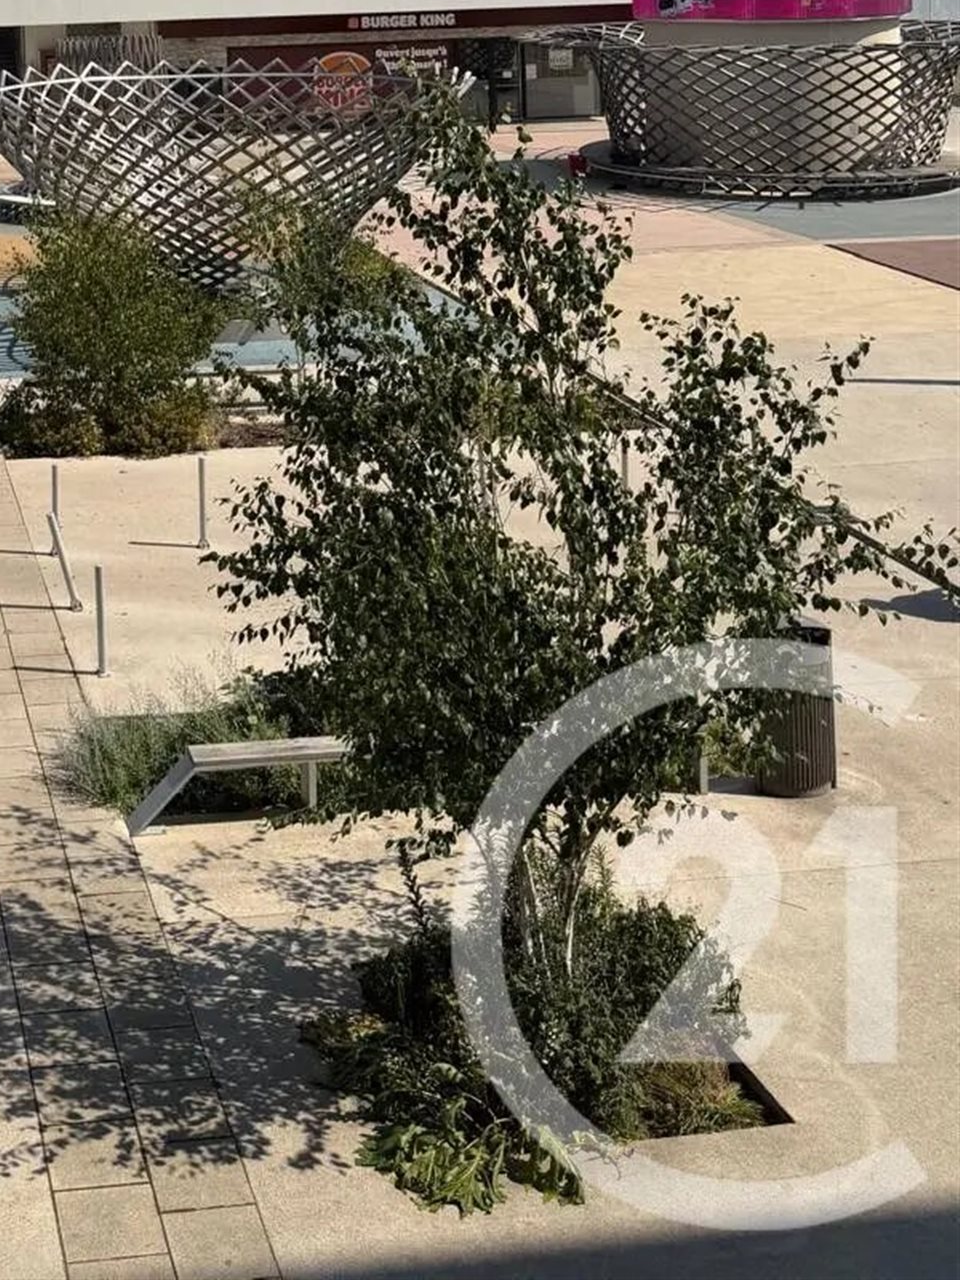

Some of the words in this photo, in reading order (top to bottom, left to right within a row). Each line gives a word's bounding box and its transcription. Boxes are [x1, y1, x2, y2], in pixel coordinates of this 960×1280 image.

[360, 14, 418, 29] BURGER
[420, 13, 456, 27] KING
[375, 47, 409, 58] Ouvert
